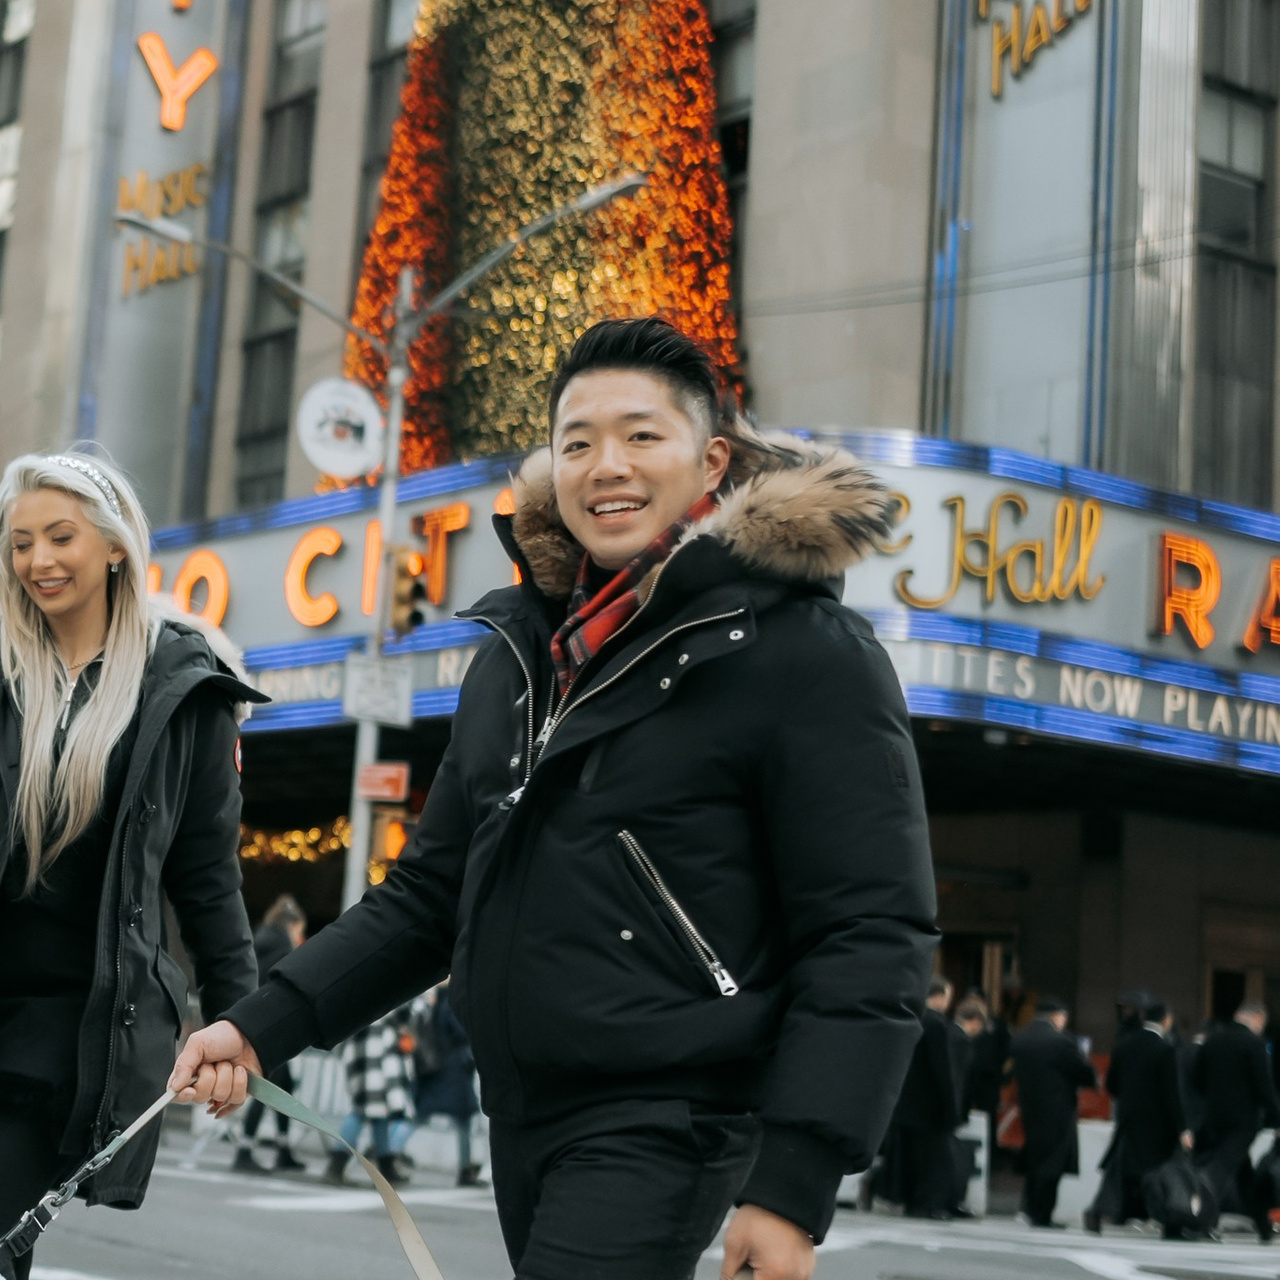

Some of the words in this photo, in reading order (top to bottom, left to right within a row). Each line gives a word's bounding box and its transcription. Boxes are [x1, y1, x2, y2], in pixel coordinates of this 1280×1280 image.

[122, 236, 198, 296] HALL
[895, 491, 1106, 608] Hall
[1059, 665, 1143, 718] NOW
